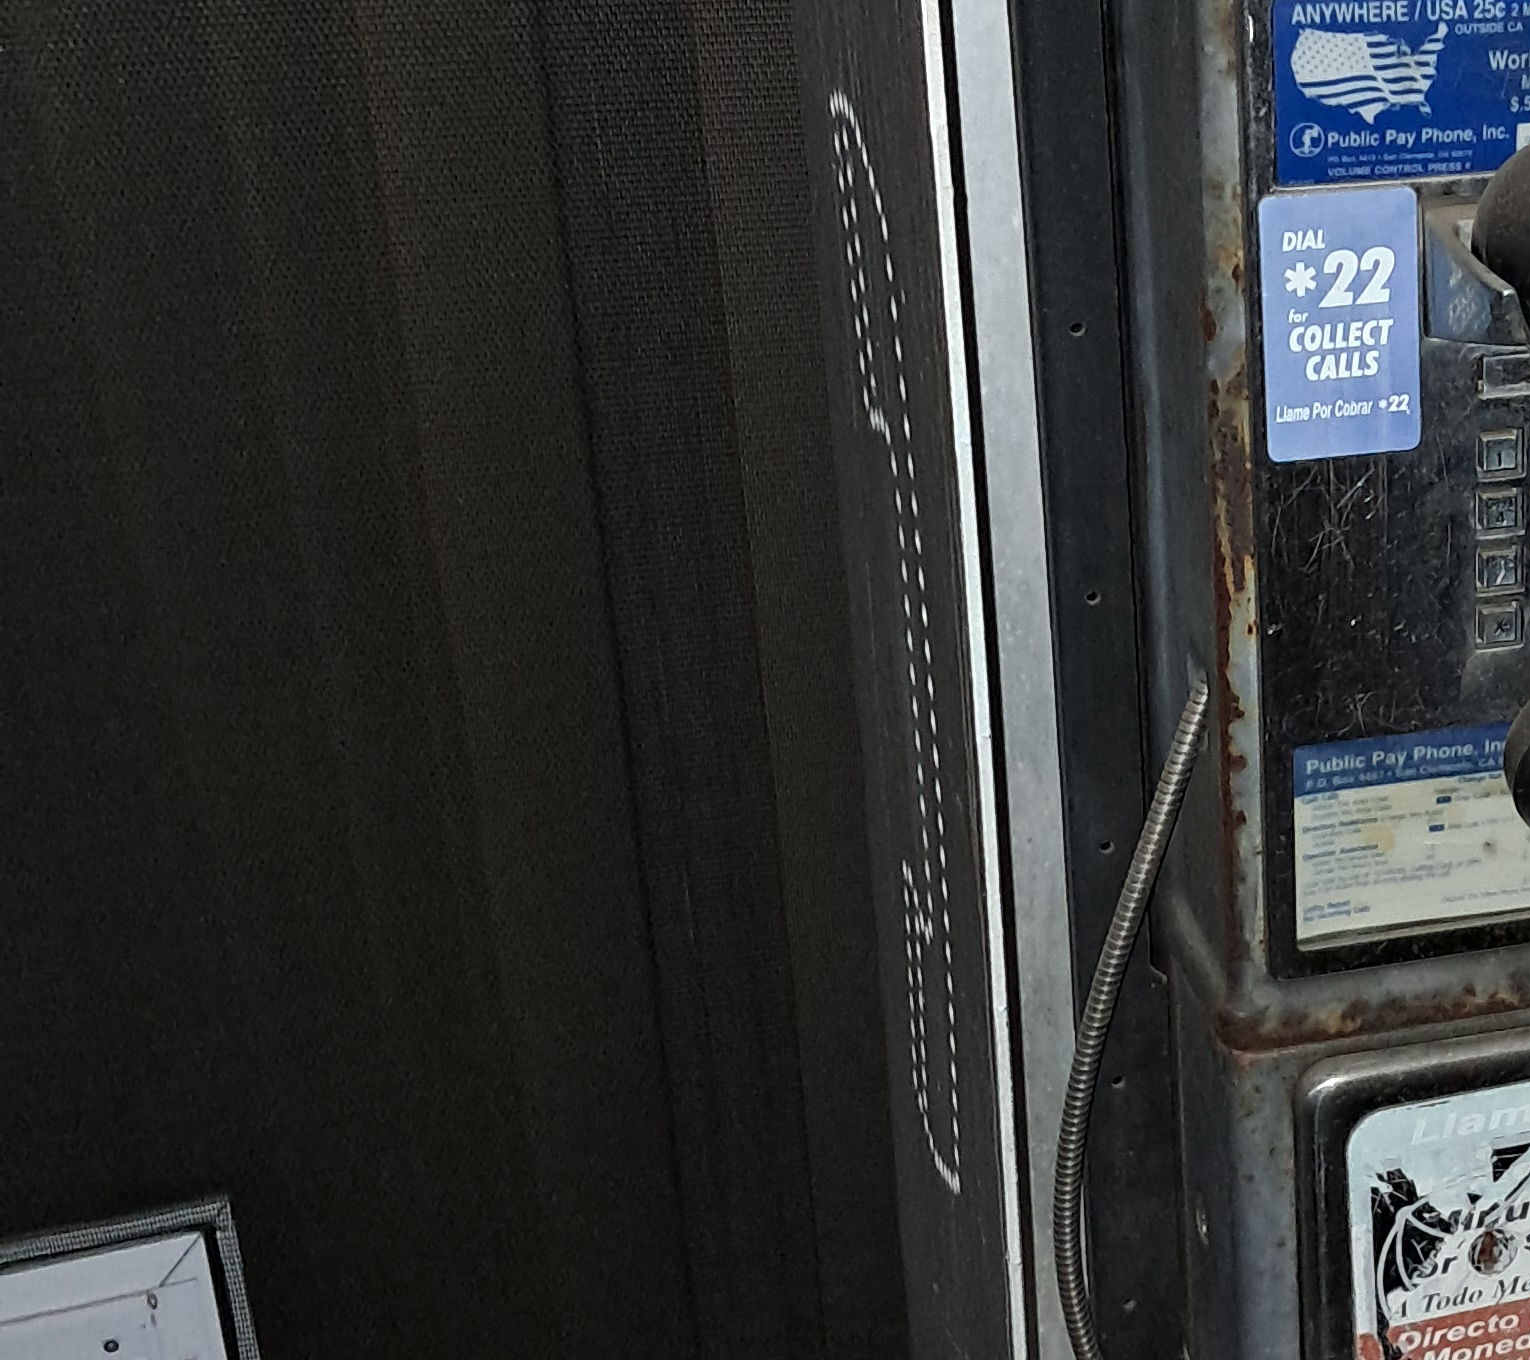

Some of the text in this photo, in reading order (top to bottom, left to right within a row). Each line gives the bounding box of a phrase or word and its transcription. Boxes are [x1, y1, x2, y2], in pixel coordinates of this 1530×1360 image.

[1291, 0, 1410, 25] ANYWHERE
[1511, 2, 1519, 17] 2
[1454, 22, 1524, 36] OUTSIDE CA
[1327, 128, 1380, 149] Public
[1385, 128, 1417, 149] Pay
[1421, 125, 1477, 144] Phone,
[1482, 123, 1511, 140] Inc.
[1282, 228, 1326, 253] DIAL
[1288, 308, 1309, 324] for
[1289, 318, 1395, 353] COLLECT
[1305, 350, 1380, 382] CALLS
[1276, 403, 1311, 424] Llame
[1312, 400, 1333, 420] Por
[1334, 398, 1374, 418] Cobrar
[1306, 755, 1366, 776] Public
[1372, 750, 1407, 768] Pay
[1484, 737, 1505, 753] In
[1422, 1285, 1484, 1314] Todo
[1397, 1312, 1520, 1354] Directo
